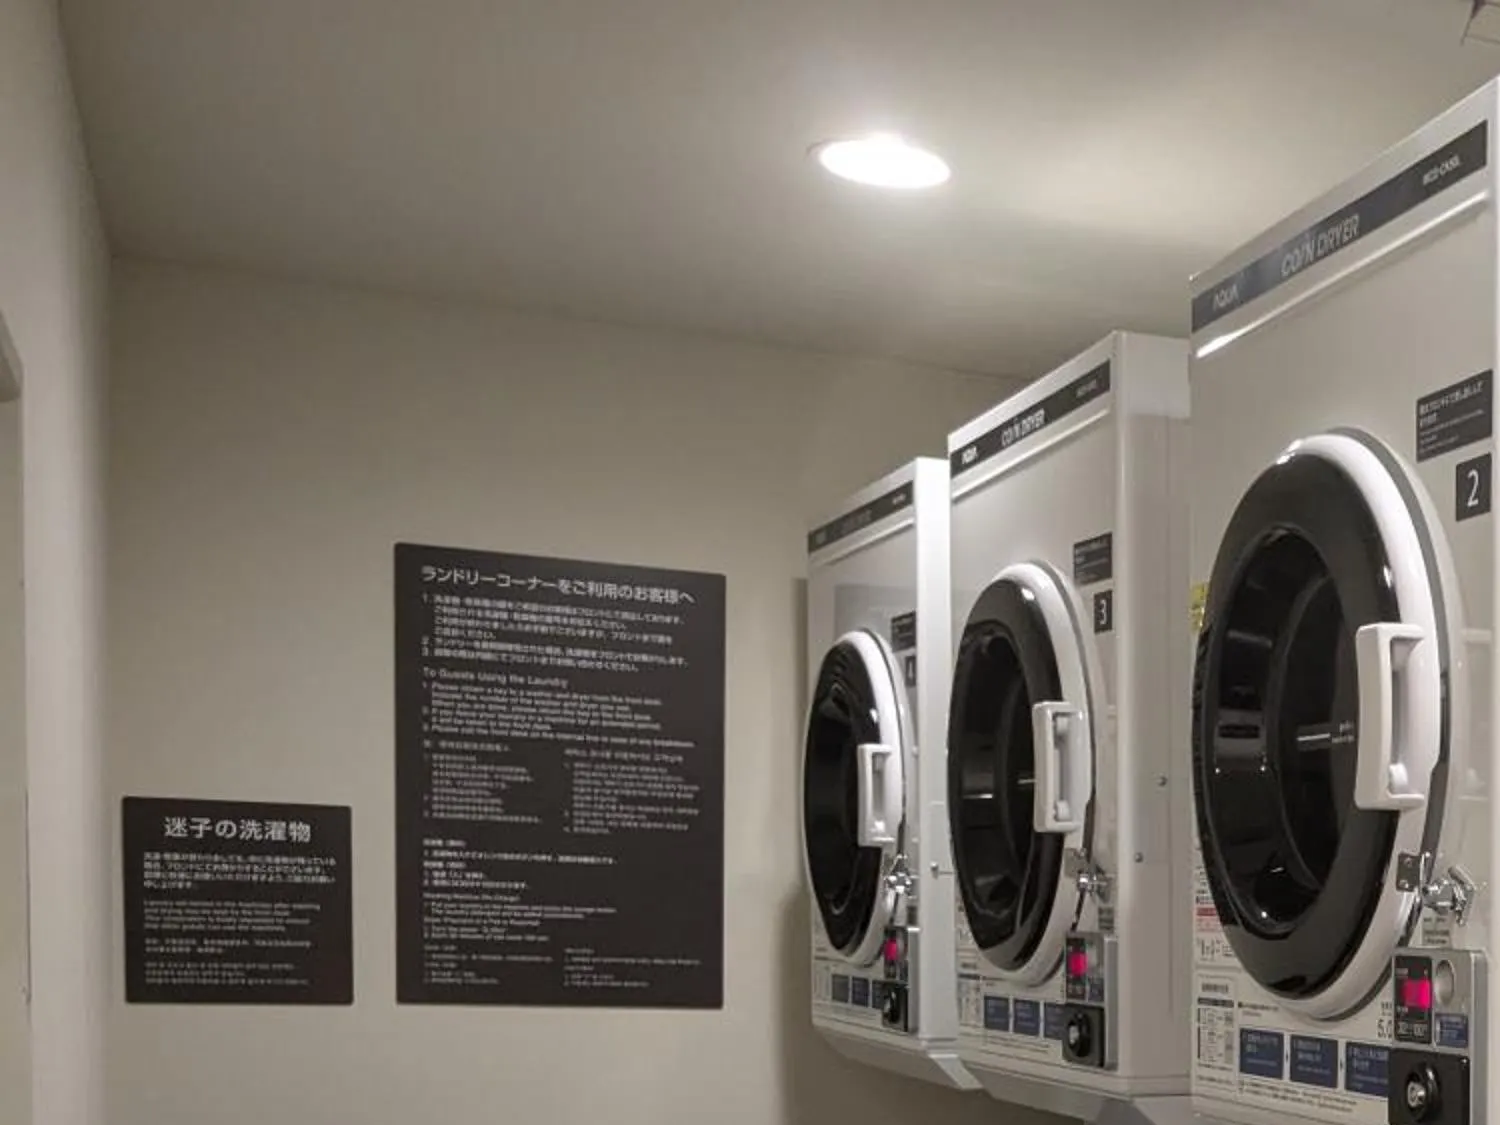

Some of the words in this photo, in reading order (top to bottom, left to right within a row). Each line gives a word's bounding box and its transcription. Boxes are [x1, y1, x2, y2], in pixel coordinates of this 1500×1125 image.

[1466, 468, 1480, 508] 2
[421, 565, 696, 605] ランドリーコーナーをご利用のお客様へ
[1100, 599, 1108, 625] 3
[164, 816, 312, 844] 迷子の洗濯物
